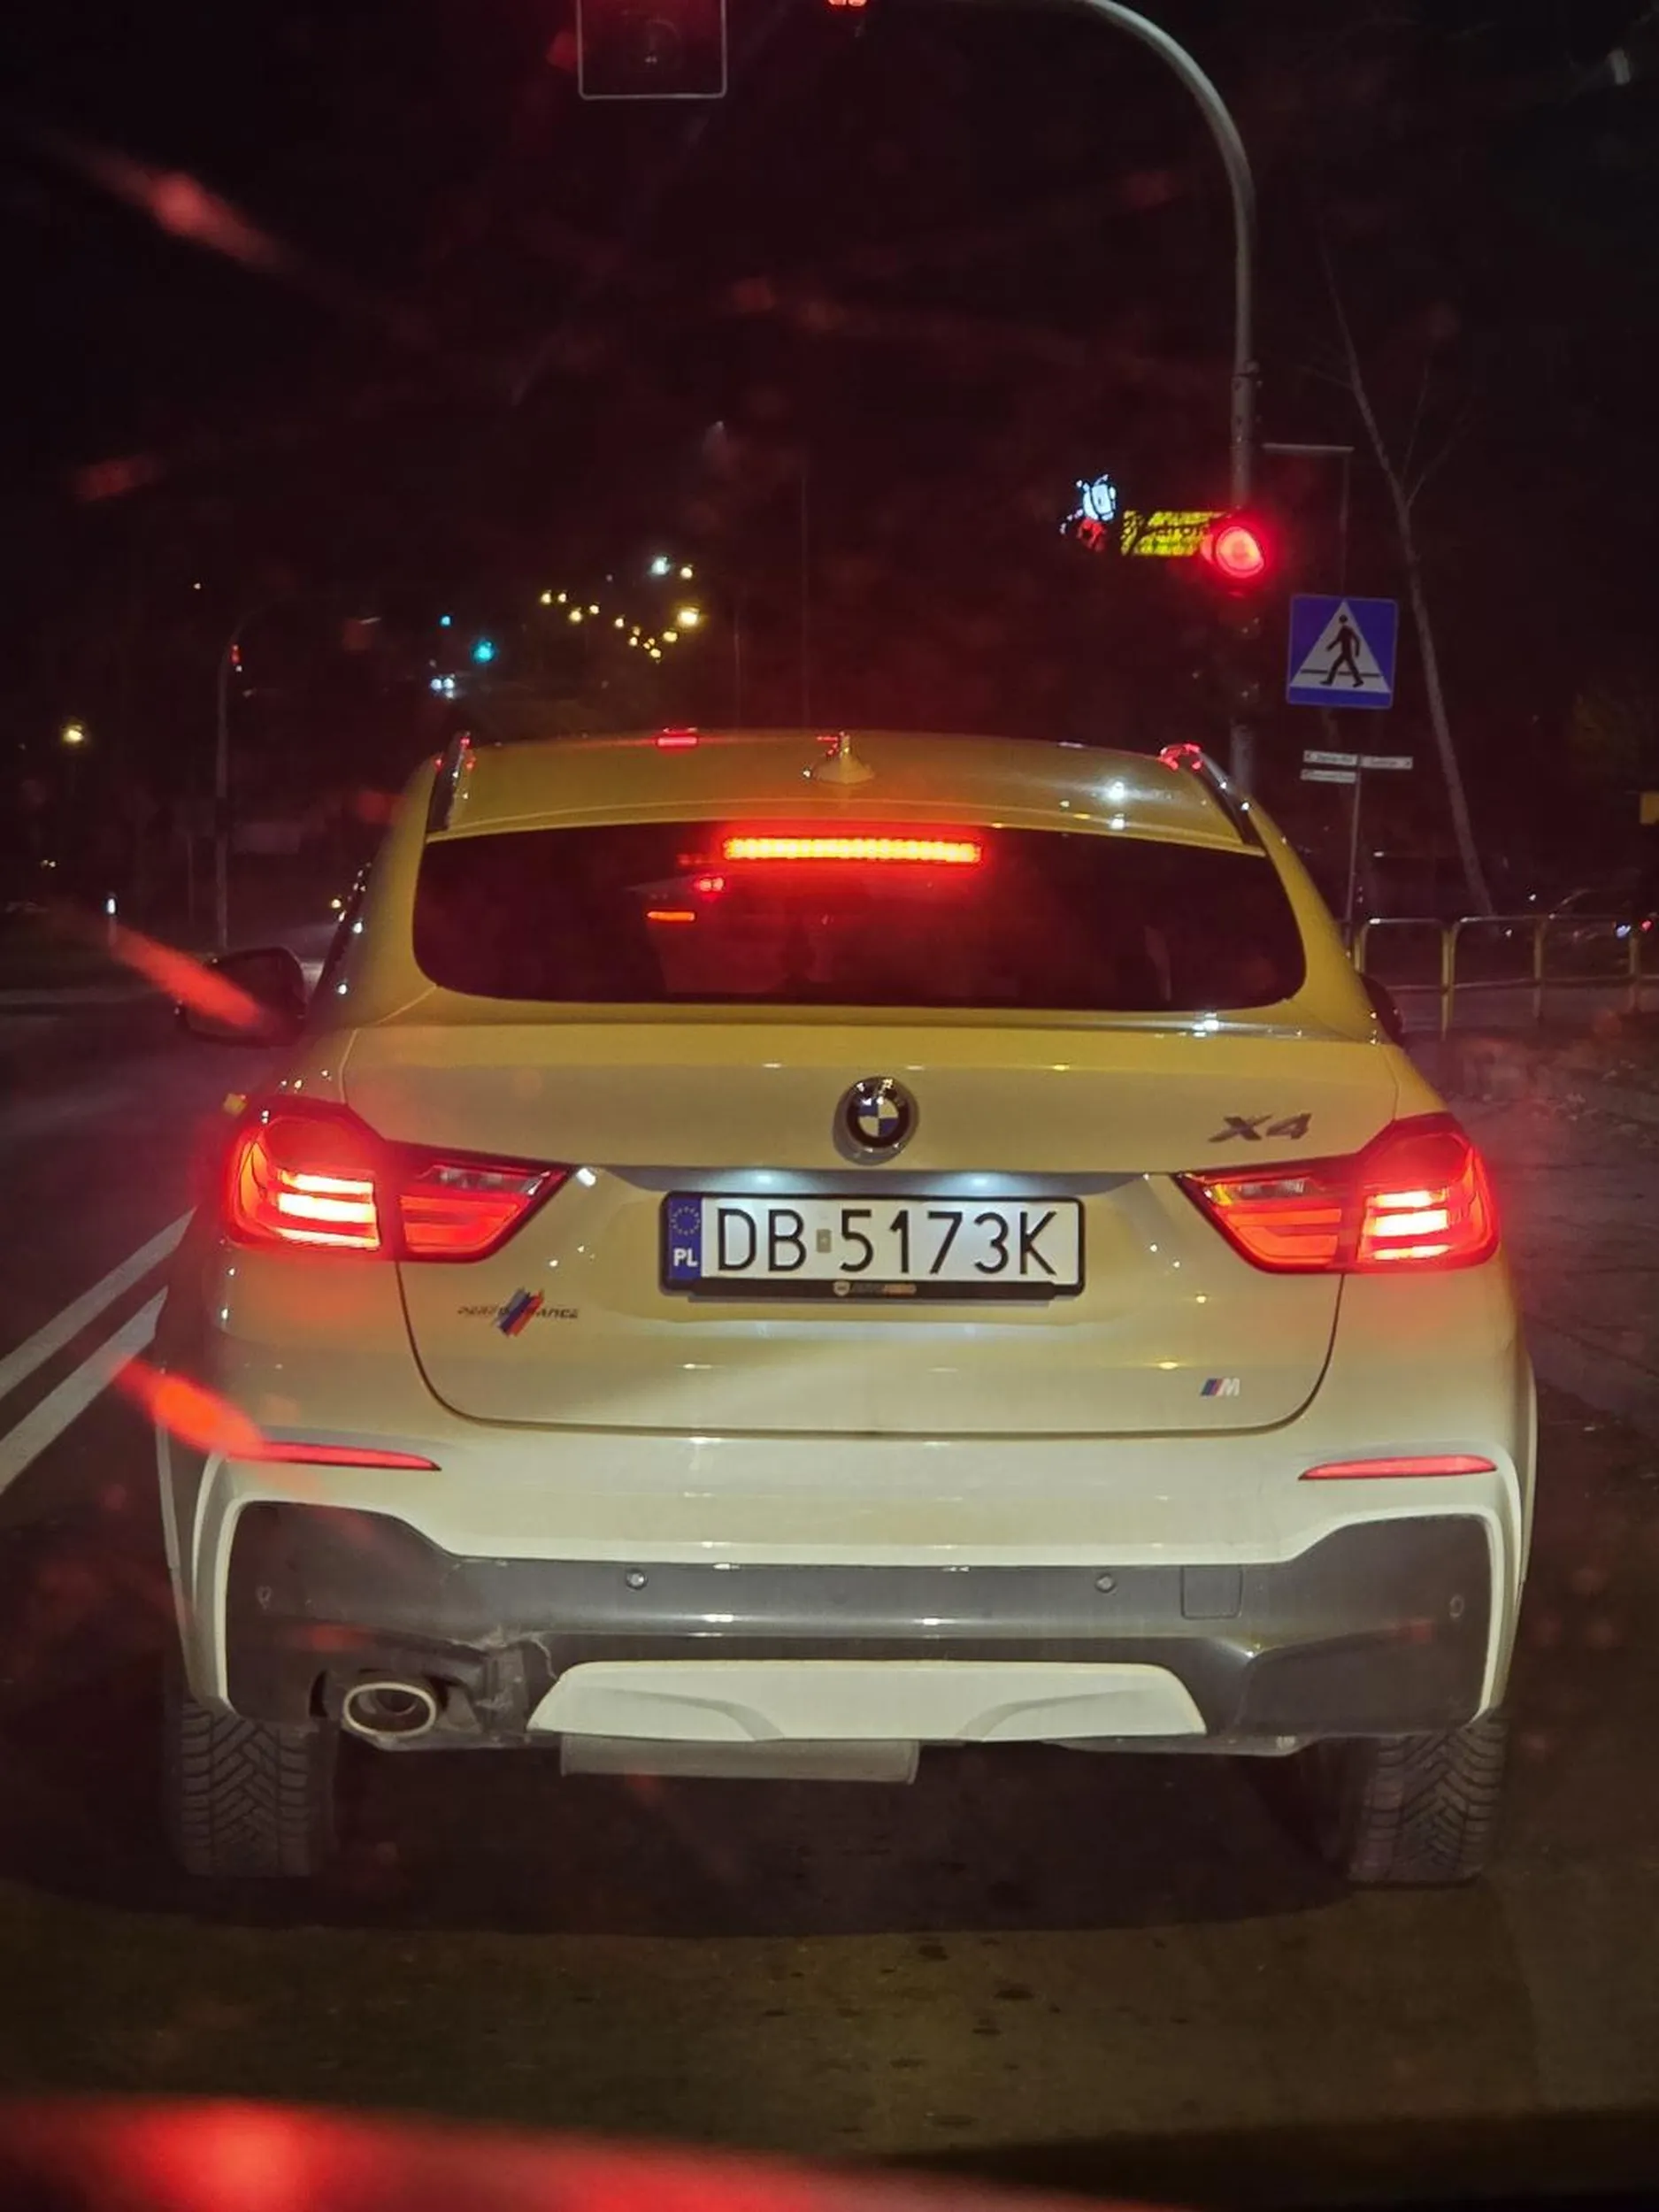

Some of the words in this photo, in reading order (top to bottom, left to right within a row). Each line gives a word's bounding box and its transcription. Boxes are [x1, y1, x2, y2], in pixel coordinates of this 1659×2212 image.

[1207, 1112, 1313, 1142] X4
[718, 1208, 807, 1272] DB
[840, 1209, 1058, 1276] 5173K
[672, 1248, 699, 1268] PL
